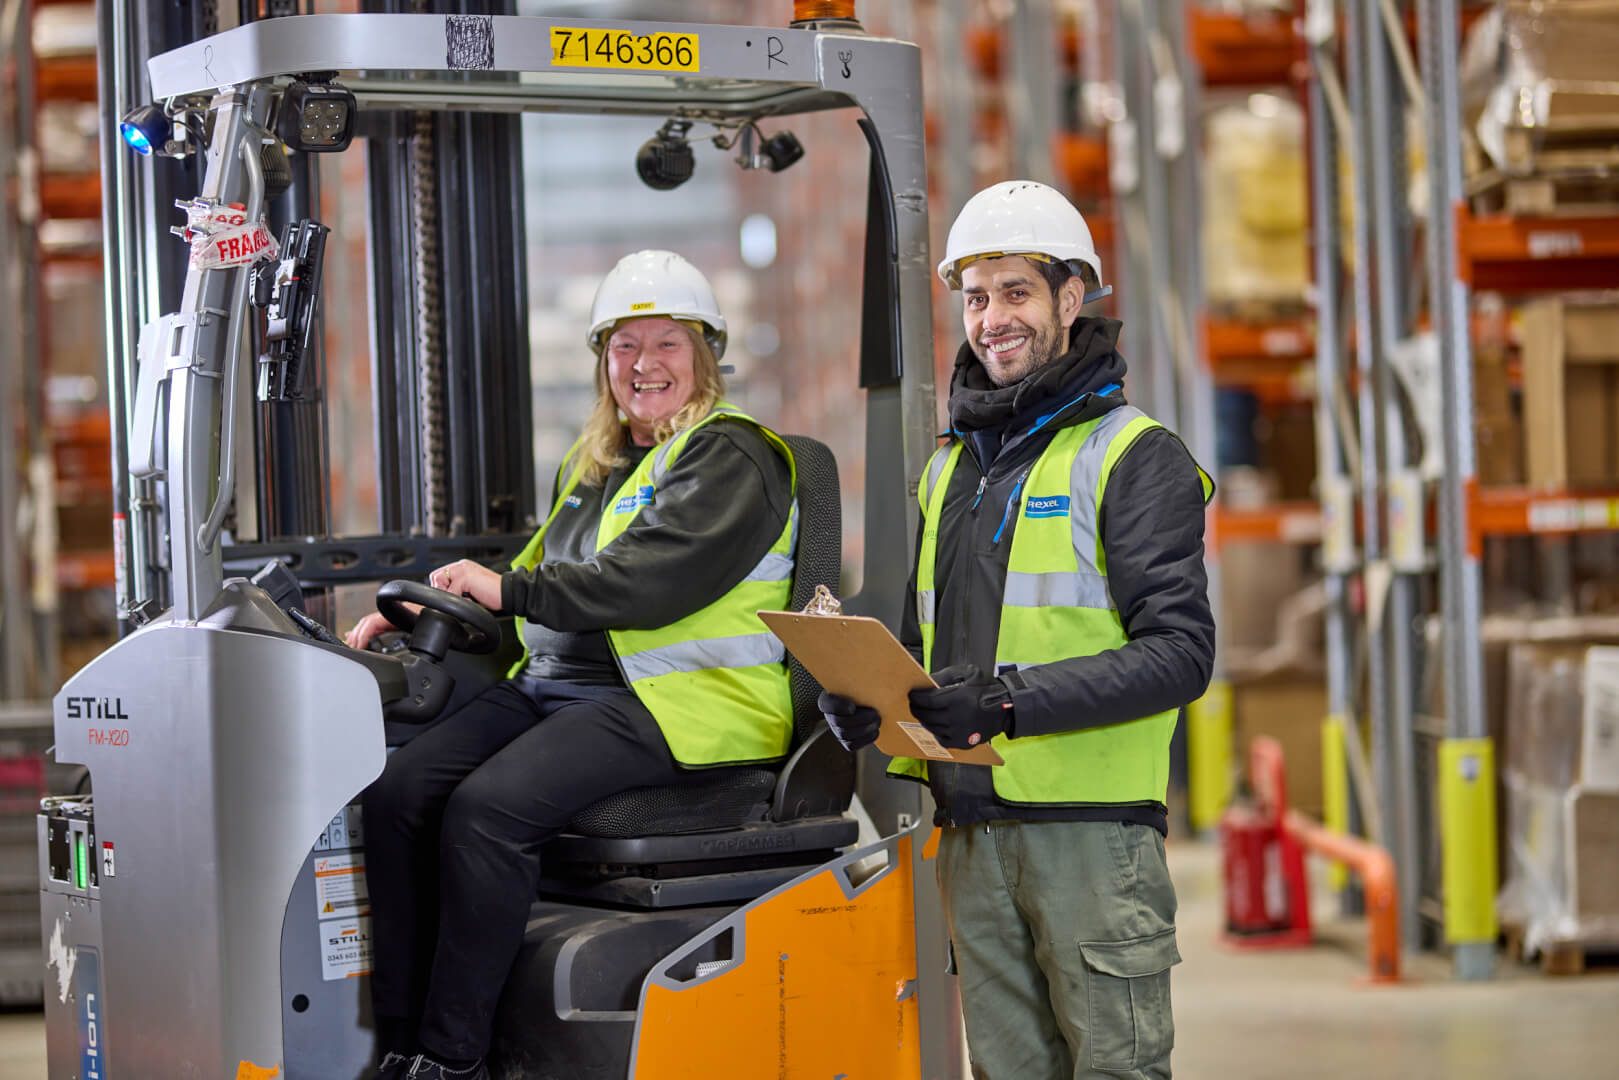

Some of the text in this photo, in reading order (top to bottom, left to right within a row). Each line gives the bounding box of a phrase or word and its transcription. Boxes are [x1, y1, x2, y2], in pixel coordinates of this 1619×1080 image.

[554, 31, 693, 66] 7146366
[767, 36, 788, 70] R
[67, 696, 129, 719] STILL
[88, 728, 129, 747] FM-X20
